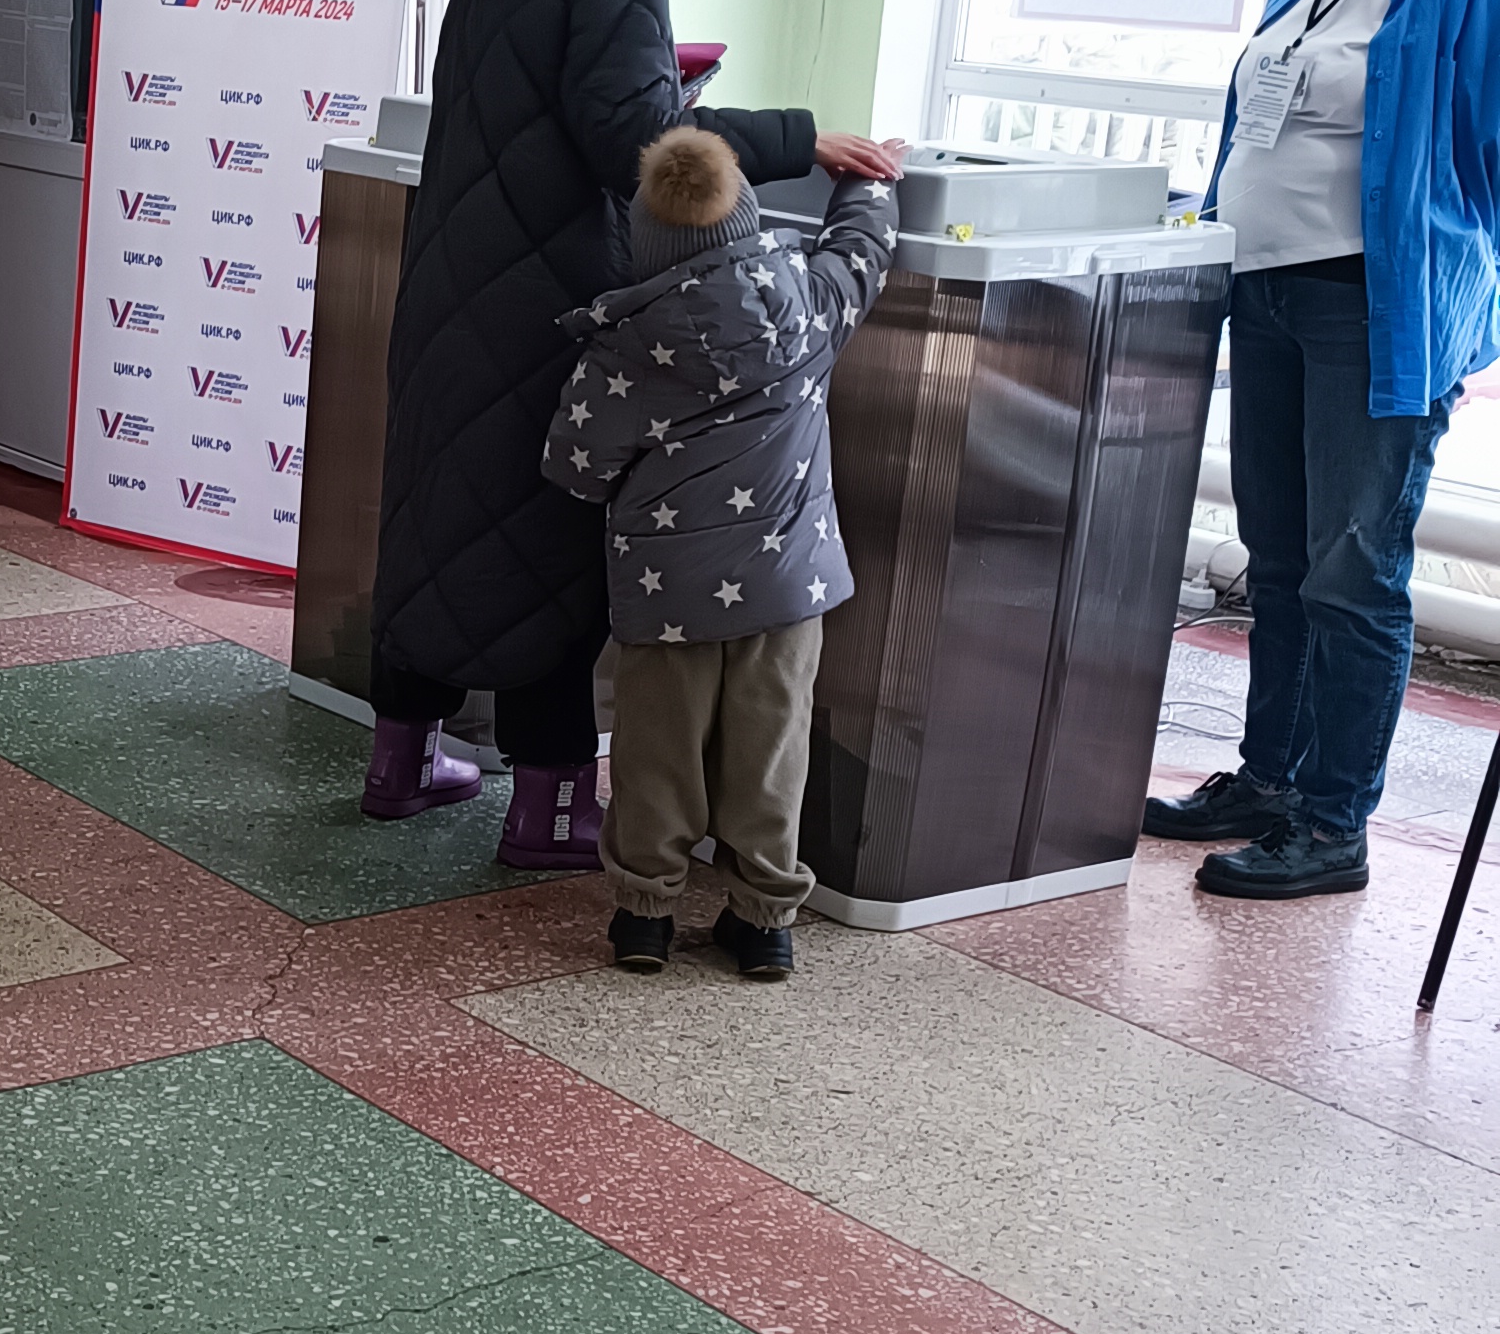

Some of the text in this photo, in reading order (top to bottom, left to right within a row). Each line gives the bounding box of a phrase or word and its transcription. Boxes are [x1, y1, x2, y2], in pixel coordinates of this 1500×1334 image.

[314, 0, 355, 21] 2024
[221, 90, 262, 105] ЦИК.РФ
[130, 137, 170, 152] ЦИК.РФ
[212, 210, 253, 226] ЦИК.РФ
[124, 251, 162, 267] ЦИК.РФ
[201, 324, 241, 340] ЦИК.РФ
[114, 362, 152, 379] ЦИК.РФ
[283, 392, 306, 408] ЦИК
[192, 434, 232, 452] ЦИК.РФ
[109, 473, 146, 491] ЦИК.РФ
[273, 508, 298, 525] ЦИК.
[419, 763, 433, 789] UGG
[553, 781, 576, 842] UGG UGG
